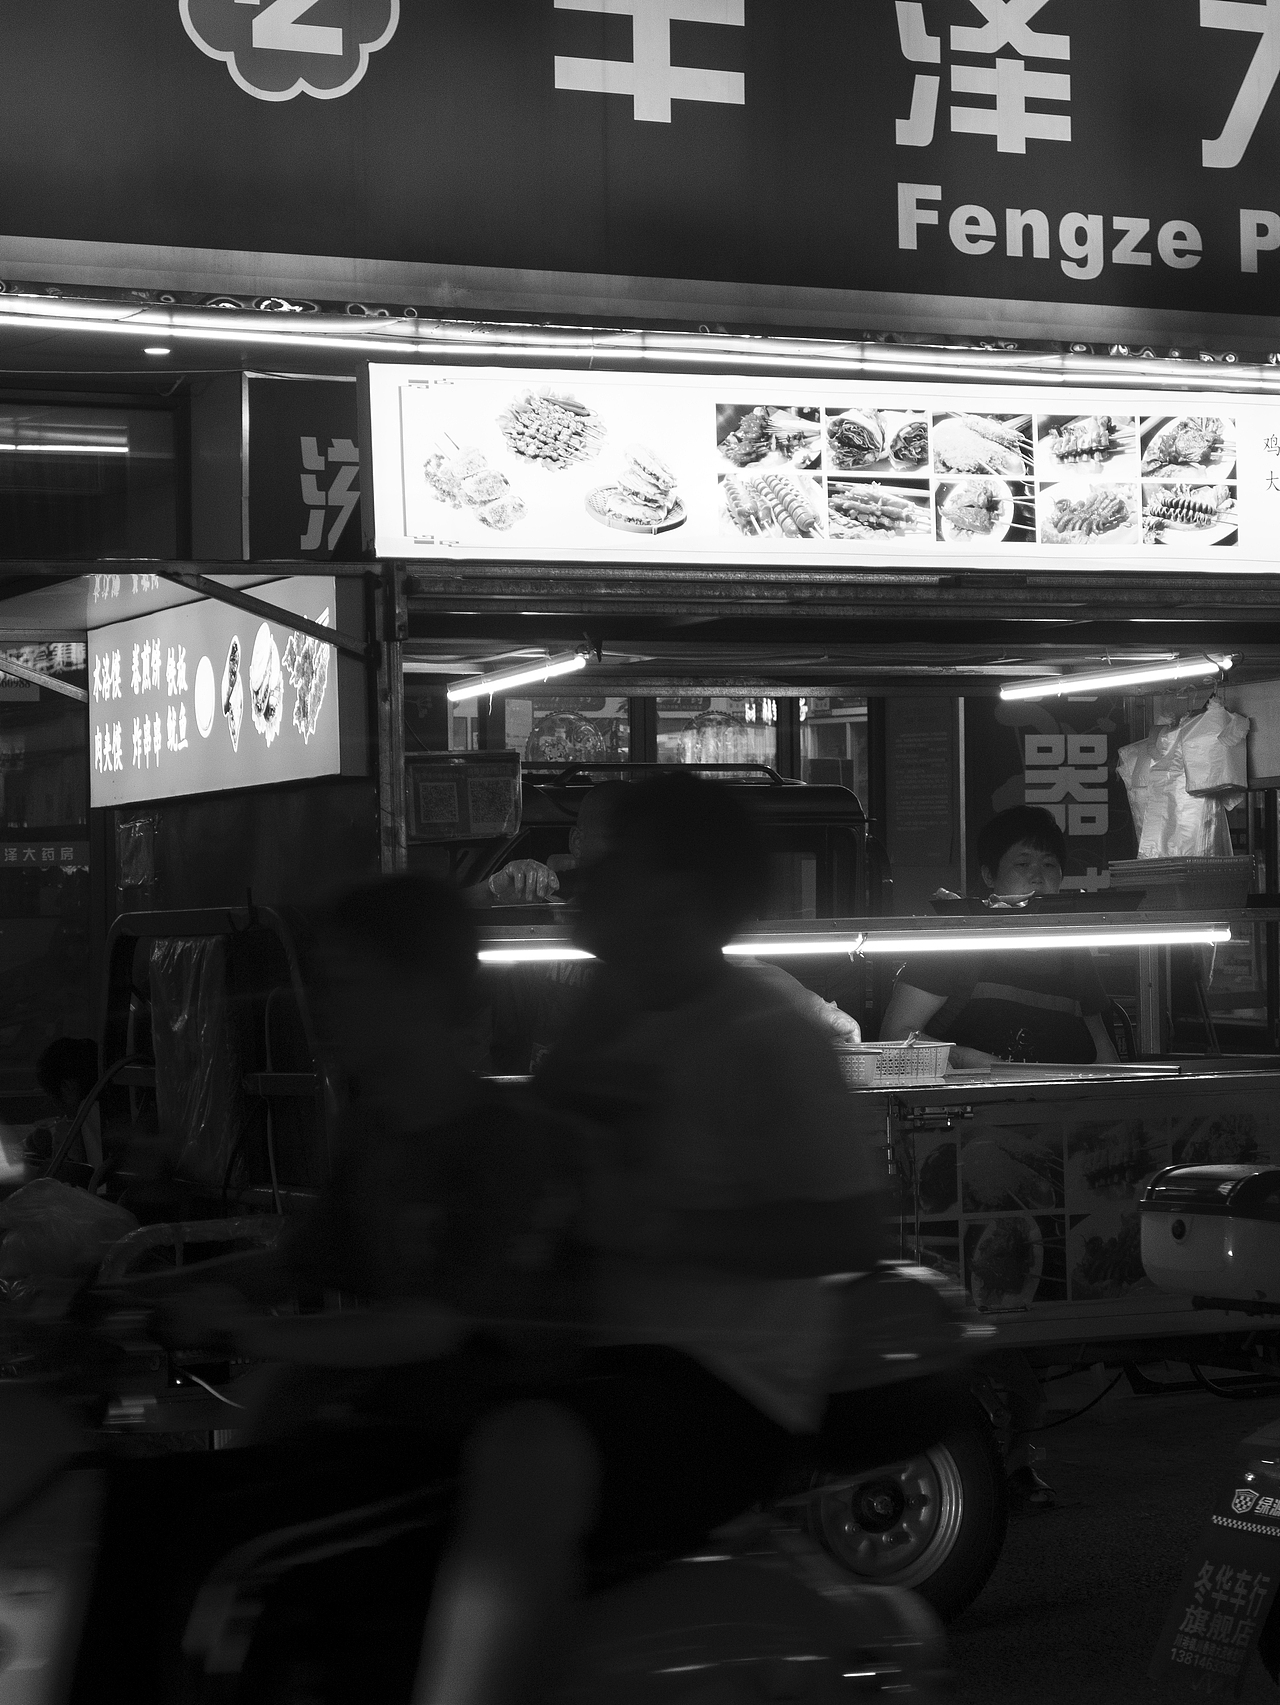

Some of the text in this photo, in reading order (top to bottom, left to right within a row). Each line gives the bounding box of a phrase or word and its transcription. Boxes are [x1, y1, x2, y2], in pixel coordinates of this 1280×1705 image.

[897, 182, 1204, 280] Fengze
[0, 675, 31, 688] 60988
[95, 702, 189, 773] 肉夹馍 炸串串 鱿鱼
[4, 846, 74, 862] 泽大药房
[1193, 1559, 1271, 1618] 冬华车行
[1178, 1604, 1257, 1647] 旗舰店
